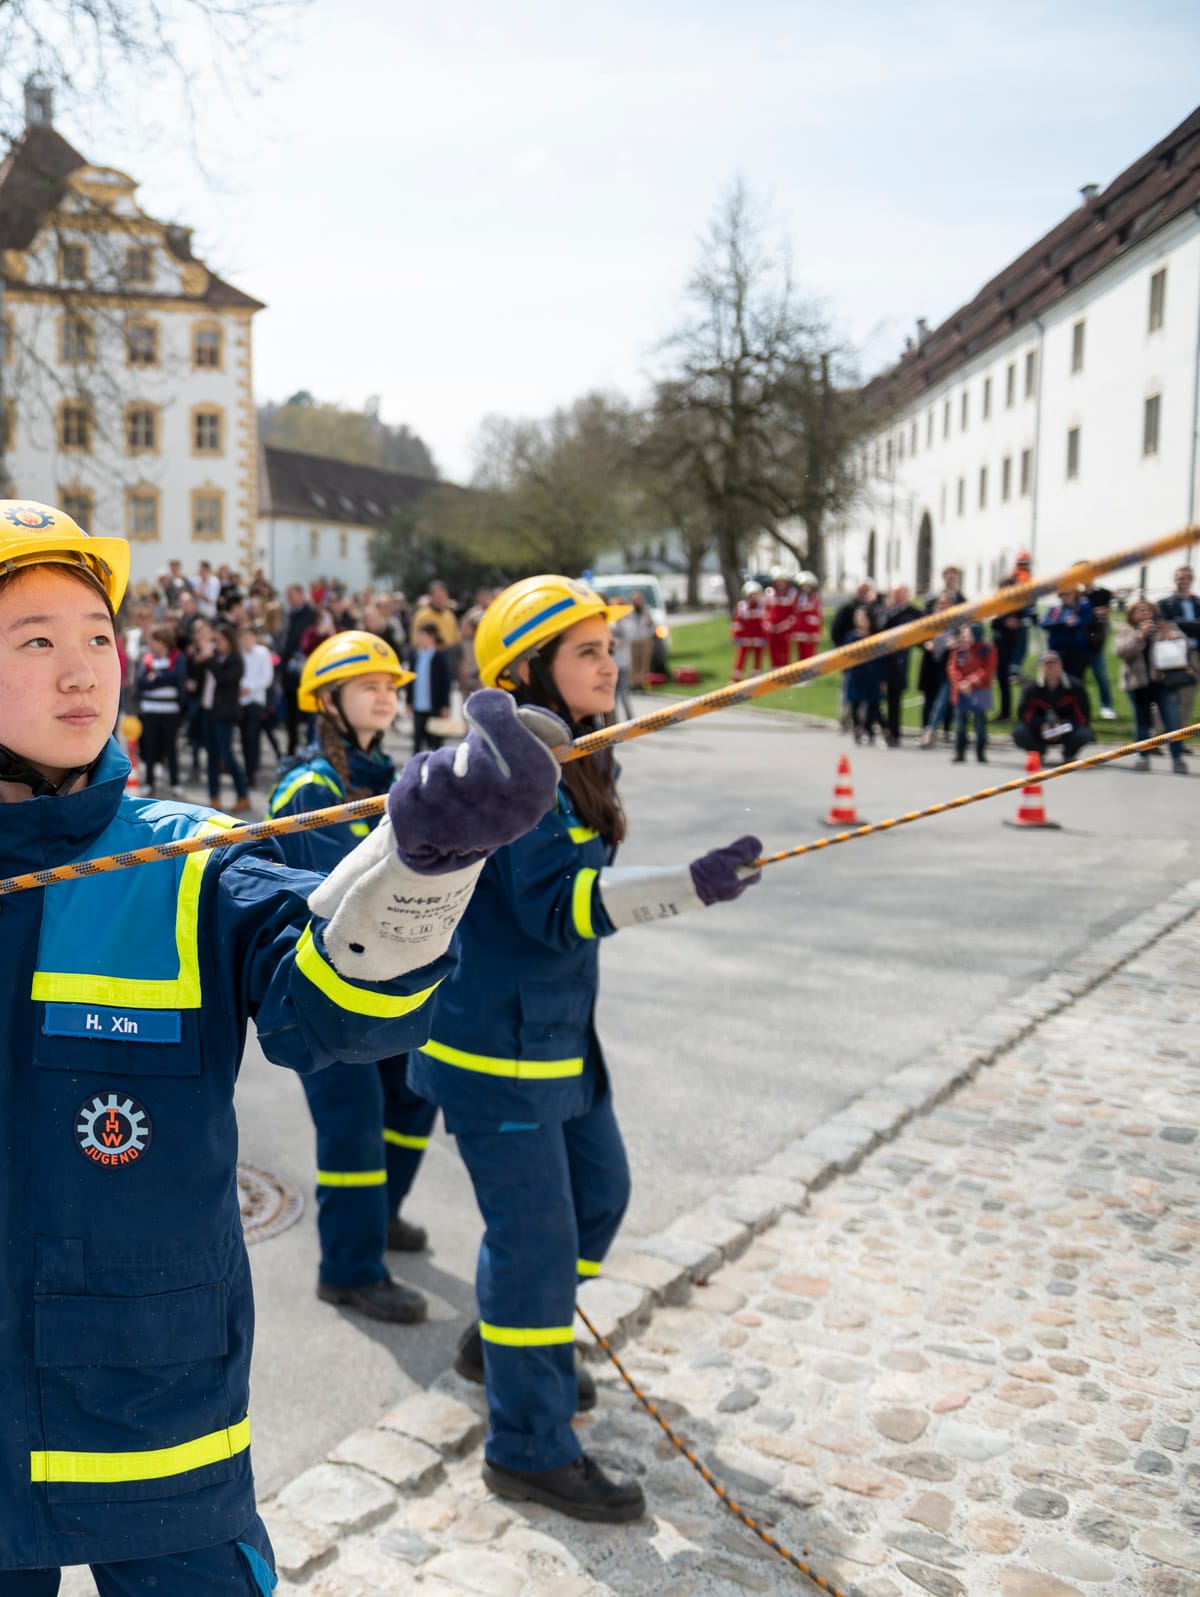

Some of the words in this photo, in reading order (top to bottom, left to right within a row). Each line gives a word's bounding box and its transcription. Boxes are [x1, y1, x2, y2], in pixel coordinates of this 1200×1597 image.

[86, 1014, 102, 1030] H.
[111, 1016, 138, 1034] Xin
[102, 1109, 123, 1146] THW
[84, 1147, 139, 1165] JUGEND
